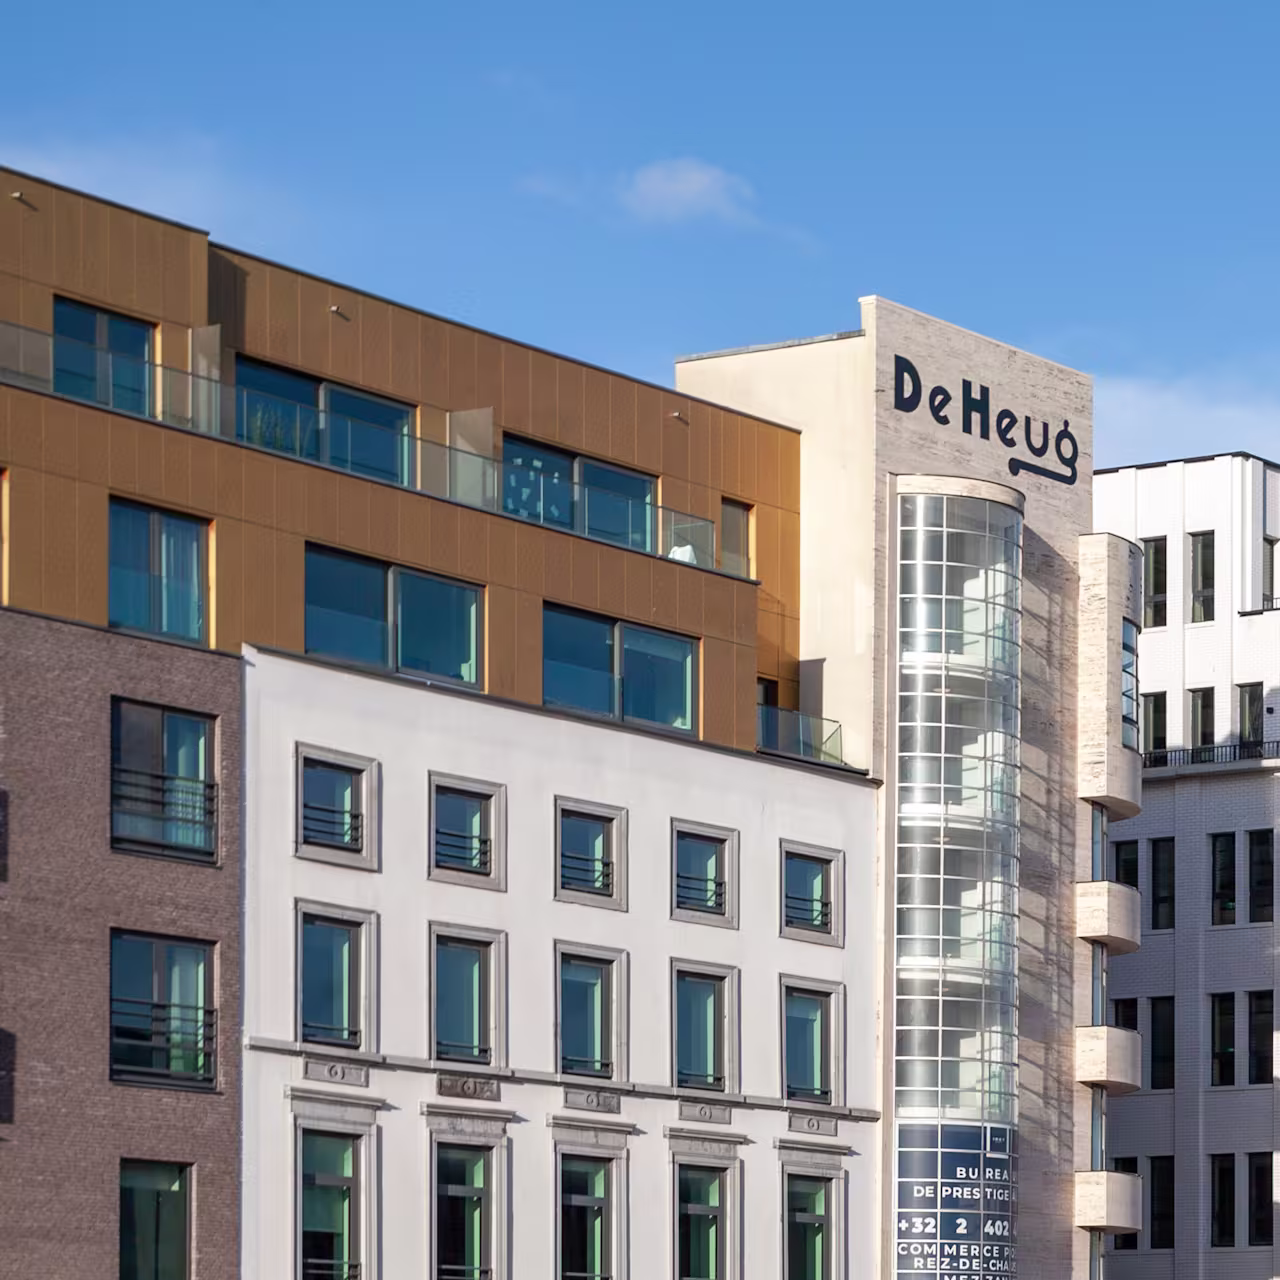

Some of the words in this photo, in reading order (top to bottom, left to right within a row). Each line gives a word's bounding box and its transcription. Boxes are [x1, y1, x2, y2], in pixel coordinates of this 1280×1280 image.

[957, 1167, 1016, 1182] BUREA
[913, 1186, 935, 1198] DE
[942, 1187, 1009, 1201] PRESTIGE
[899, 1217, 936, 1234] +32
[956, 1218, 967, 1234] 2
[984, 1219, 1009, 1236] 402
[898, 1244, 999, 1257] COMMERCE
